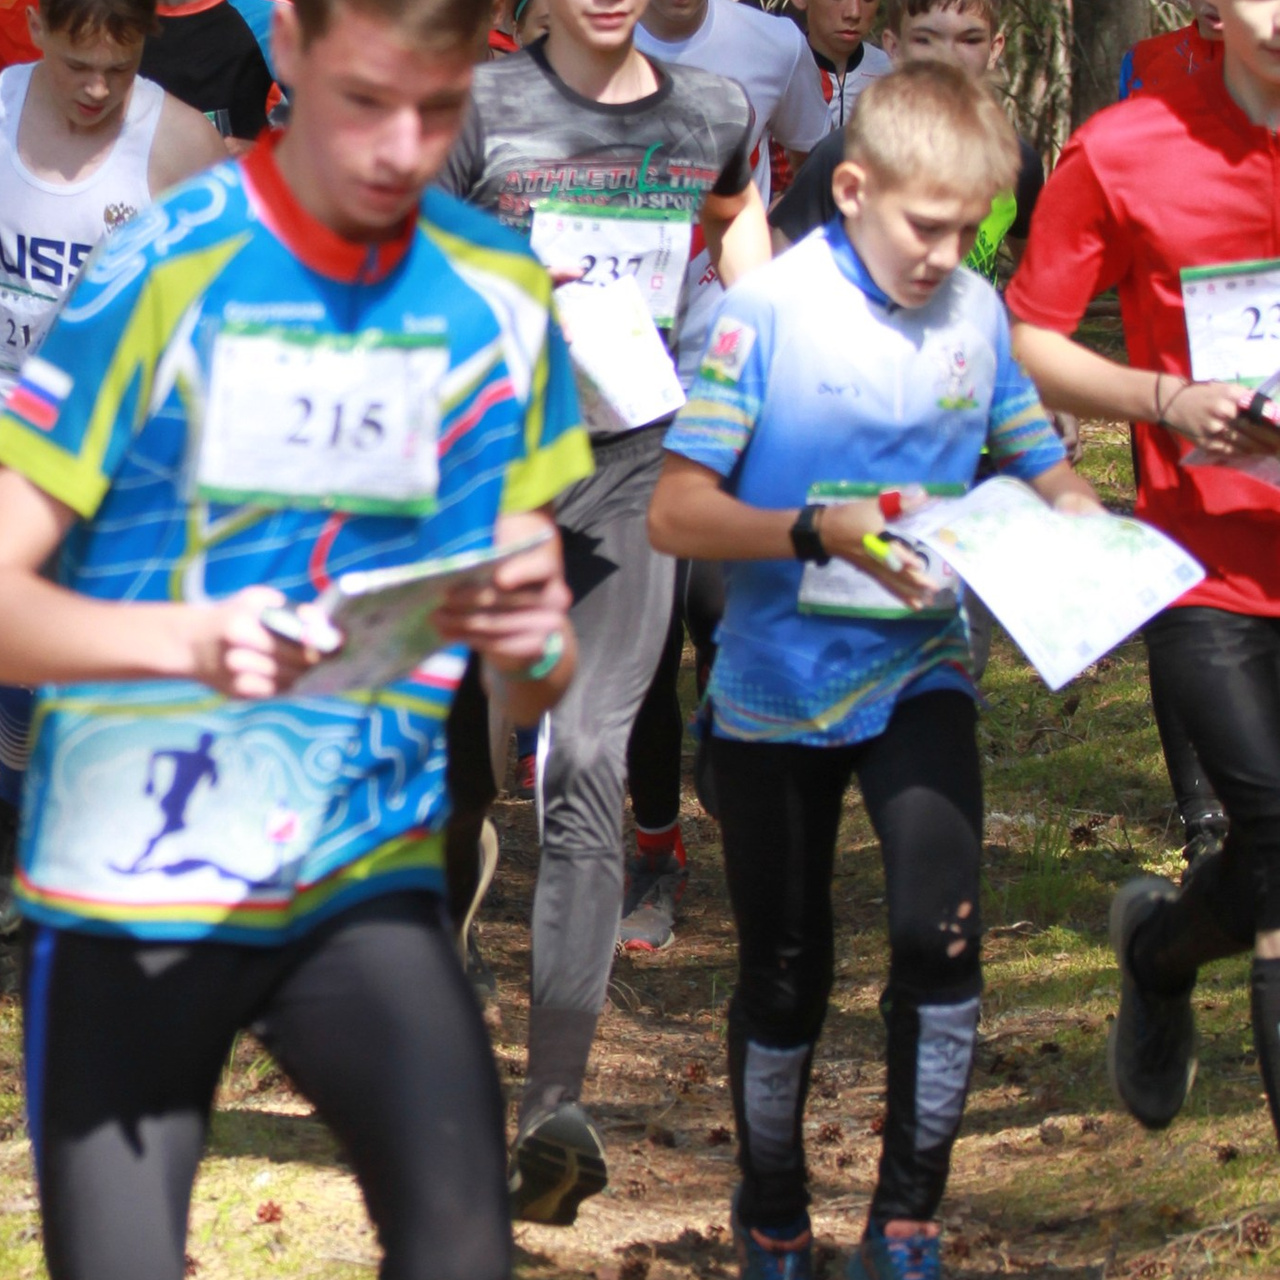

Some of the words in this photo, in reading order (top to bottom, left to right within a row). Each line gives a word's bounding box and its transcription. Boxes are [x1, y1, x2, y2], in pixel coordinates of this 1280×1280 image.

[576, 254, 642, 288] 237
[6, 318, 43, 349] 21
[285, 396, 387, 449] 215
